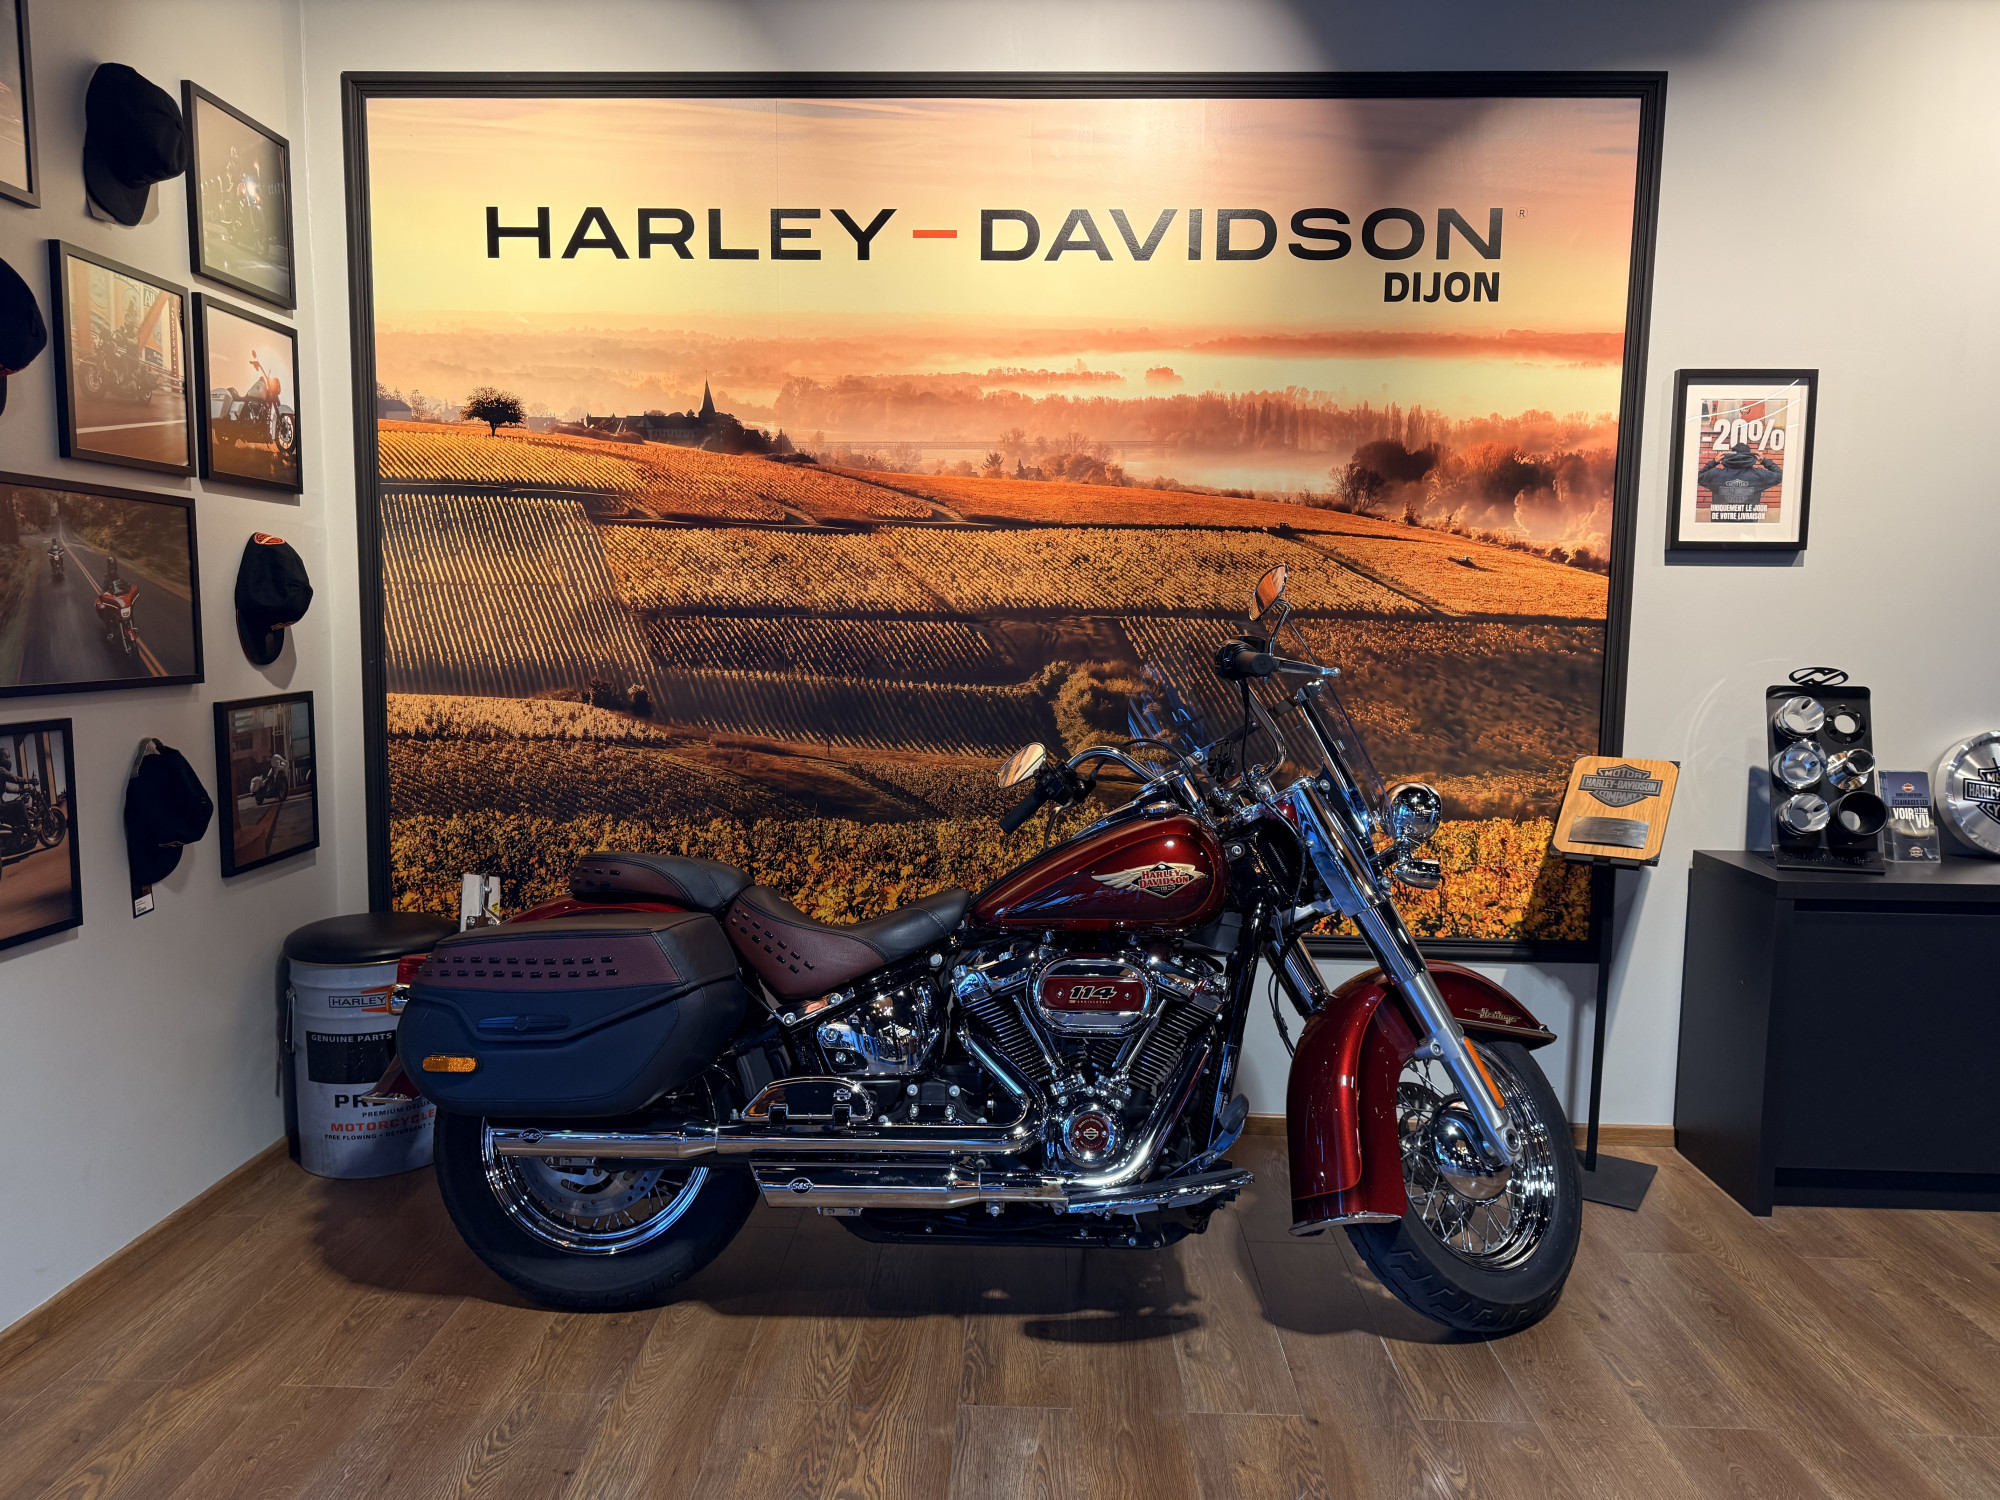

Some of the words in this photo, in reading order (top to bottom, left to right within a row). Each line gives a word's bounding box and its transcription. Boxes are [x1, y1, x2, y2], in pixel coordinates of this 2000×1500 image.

[1384, 271, 1500, 304] DIJON
[1702, 418, 1785, 451] -20%
[1711, 504, 1745, 512] UNIQUEMENT
[1745, 504, 1753, 512] LE
[1753, 504, 1768, 512] JOUR
[1712, 512, 1719, 520] DE
[1720, 512, 1736, 520] VOTRE
[1738, 512, 1766, 520] LIVRAISON
[1603, 769, 1643, 780] MOTOR
[1585, 777, 1657, 792] HARLEY-DAVIDSON
[1599, 790, 1638, 804] COMPANY
[1892, 807, 1914, 820] VOIR
[1915, 814, 1930, 829] VU
[1141, 869, 1181, 880] HARLEY
[1138, 876, 1189, 889] DAVIDSON
[1069, 986, 1117, 1000] 114
[332, 995, 387, 1006] HARLEY
[311, 1034, 354, 1043] GENUINE
[358, 1032, 393, 1043] PARTS
[362, 1108, 404, 1118] PREMIUM
[406, 1101, 431, 1111] DELUX
[331, 1109, 435, 1132] MOTORCYCLE
[325, 1133, 340, 1141] FREE
[342, 1133, 377, 1141] FLOWING
[385, 1123, 426, 1138] DETERGENT
